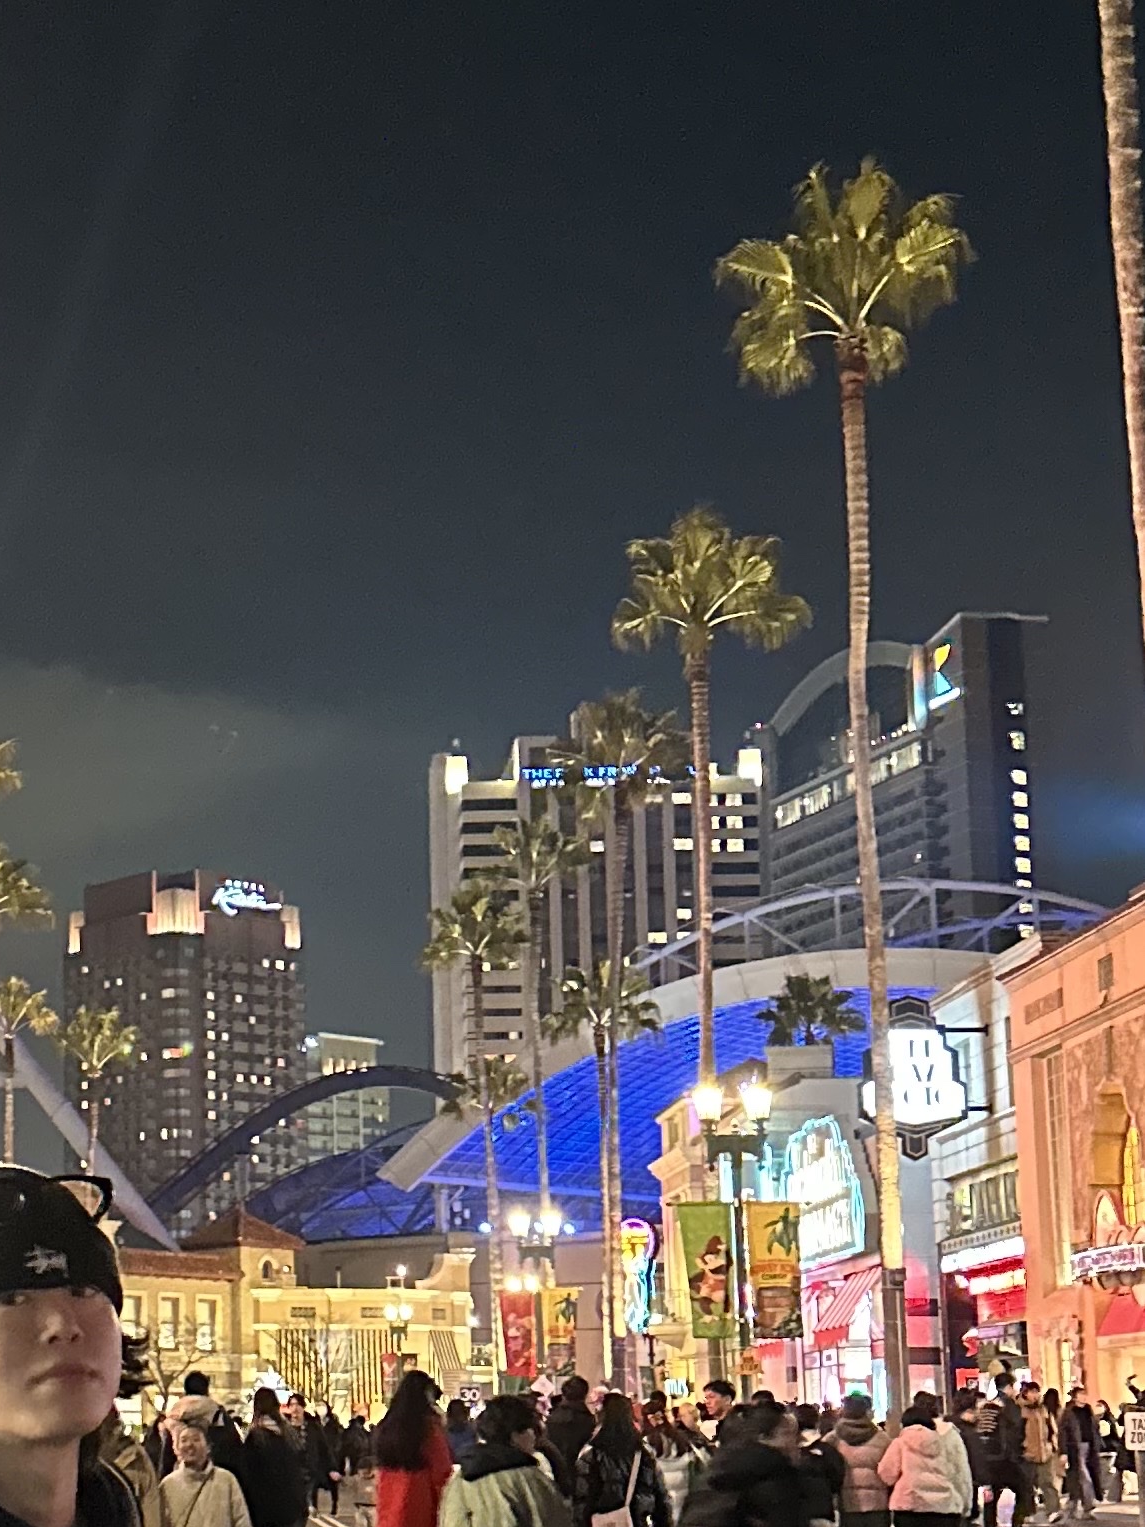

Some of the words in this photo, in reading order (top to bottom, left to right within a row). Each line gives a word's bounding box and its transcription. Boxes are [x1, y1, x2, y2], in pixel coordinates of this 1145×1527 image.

[460, 1388, 481, 1401] 30
[1131, 1418, 1145, 1430] TA
[1130, 1431, 1145, 1444] ZO
